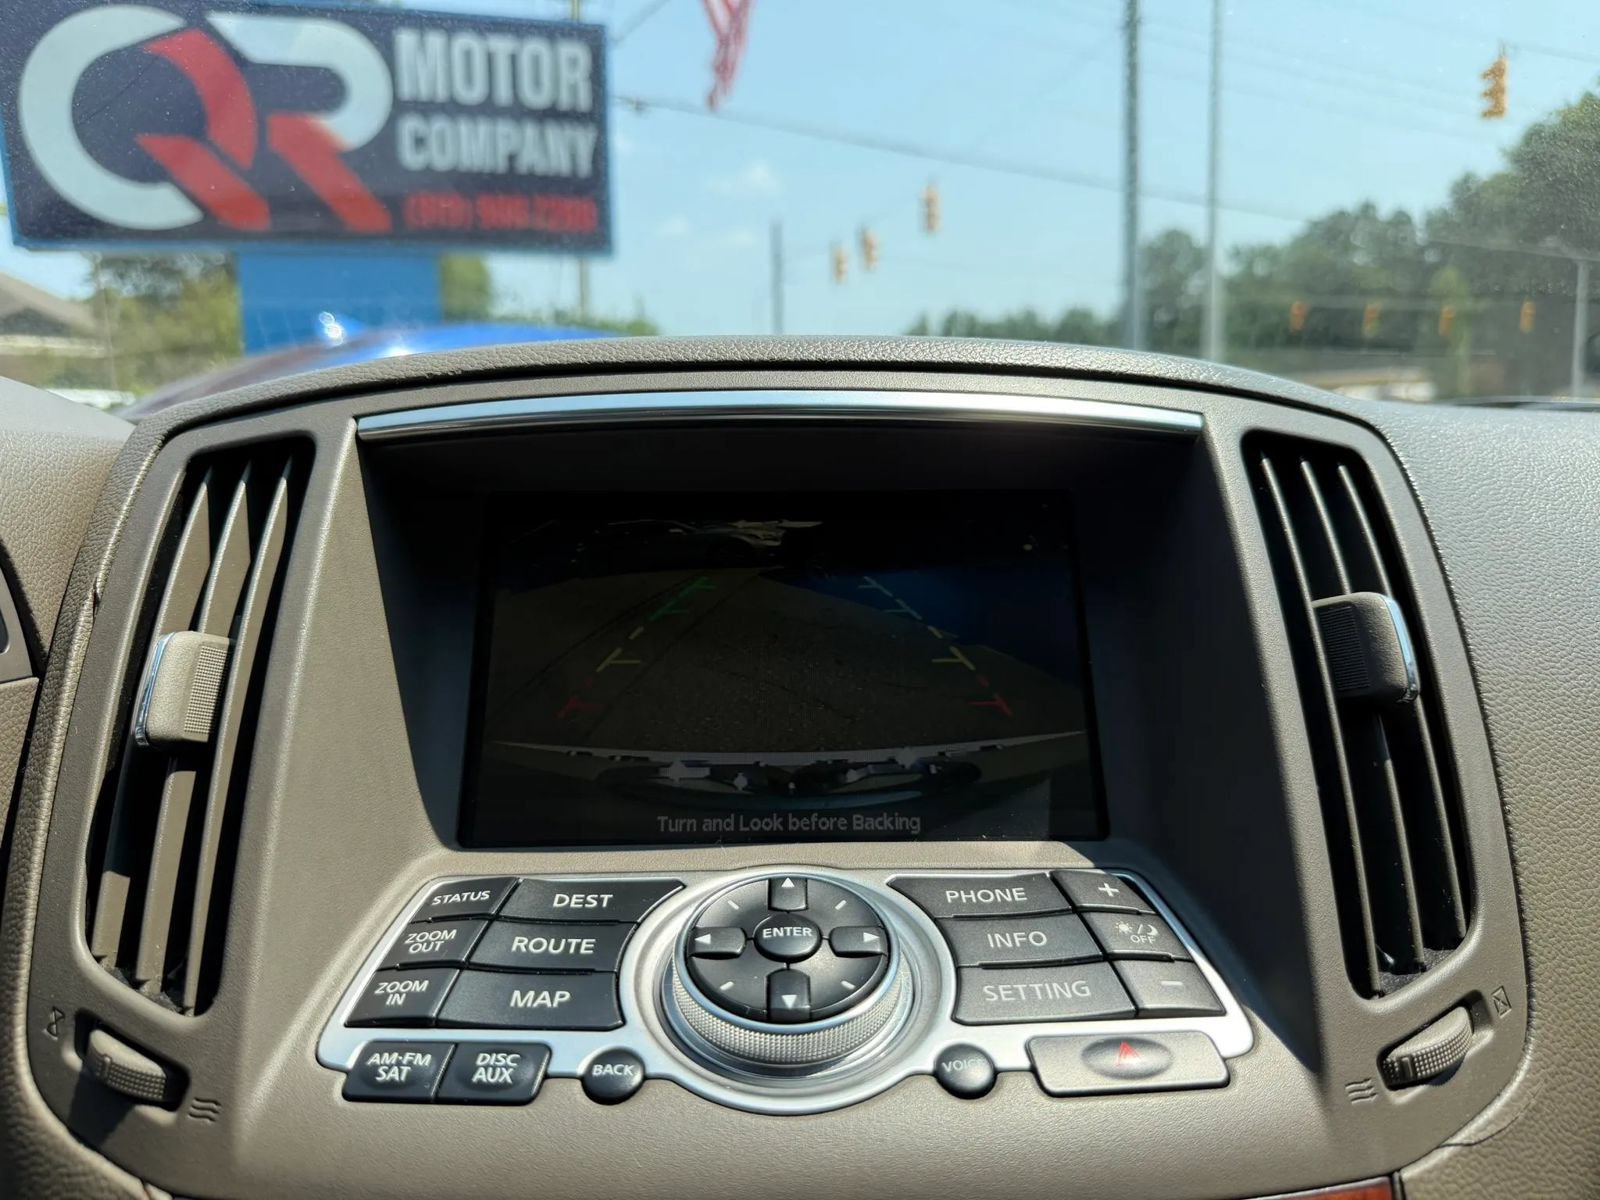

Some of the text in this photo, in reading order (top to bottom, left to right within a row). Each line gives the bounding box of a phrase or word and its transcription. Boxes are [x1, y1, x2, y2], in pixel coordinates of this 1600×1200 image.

[394, 27, 594, 111] MOTOR
[398, 112, 598, 178] COMPANY
[657, 811, 922, 835] Turn and Look before Backing
[431, 890, 491, 906] STATUS
[552, 893, 613, 909] DEST
[945, 887, 1028, 904] PHONE
[404, 929, 457, 945] ZOOM
[762, 926, 813, 939] ENTER
[986, 930, 1048, 948] INFO
[1130, 934, 1157, 944] OFF
[409, 940, 445, 954] OUT
[511, 936, 596, 955] ROUTE
[374, 980, 429, 995] ZOOM
[983, 979, 1092, 1002] SETTING
[386, 993, 406, 1006] IN
[510, 989, 571, 1008] MAP
[475, 1052, 521, 1067] DISC
[376, 1065, 411, 1082] SAT
[472, 1067, 514, 1084] AUX
[592, 1063, 636, 1077] BACK
